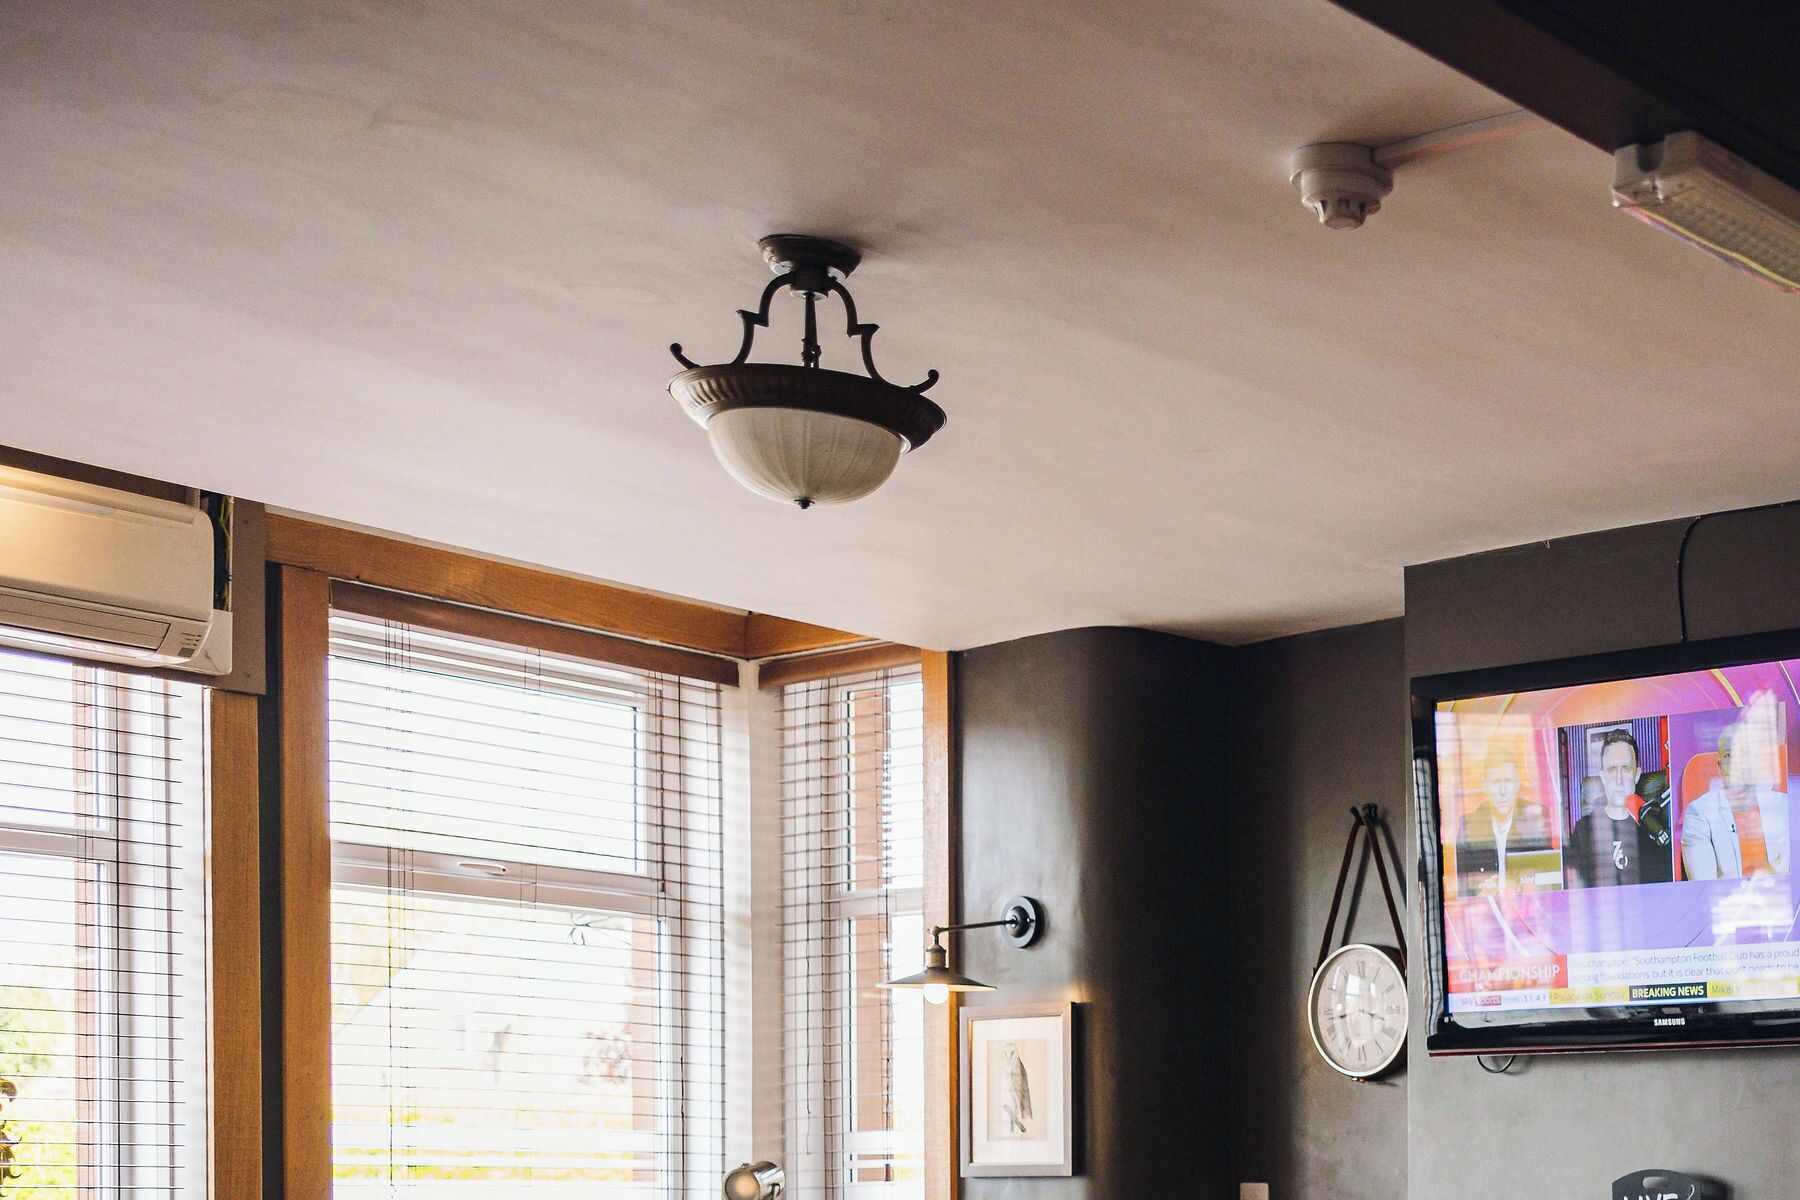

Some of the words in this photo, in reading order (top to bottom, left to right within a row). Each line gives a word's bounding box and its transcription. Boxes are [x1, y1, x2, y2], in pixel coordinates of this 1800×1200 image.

[1749, 950, 1765, 959] has
[1774, 949, 1799, 960] proud
[1459, 964, 1560, 983] CHAMPIONSHIP
[1684, 967, 1704, 976] clear
[1632, 986, 1677, 998] BREAKING
[1677, 985, 1704, 996] NEWS
[1653, 1017, 1685, 1027] SAMSUNG
